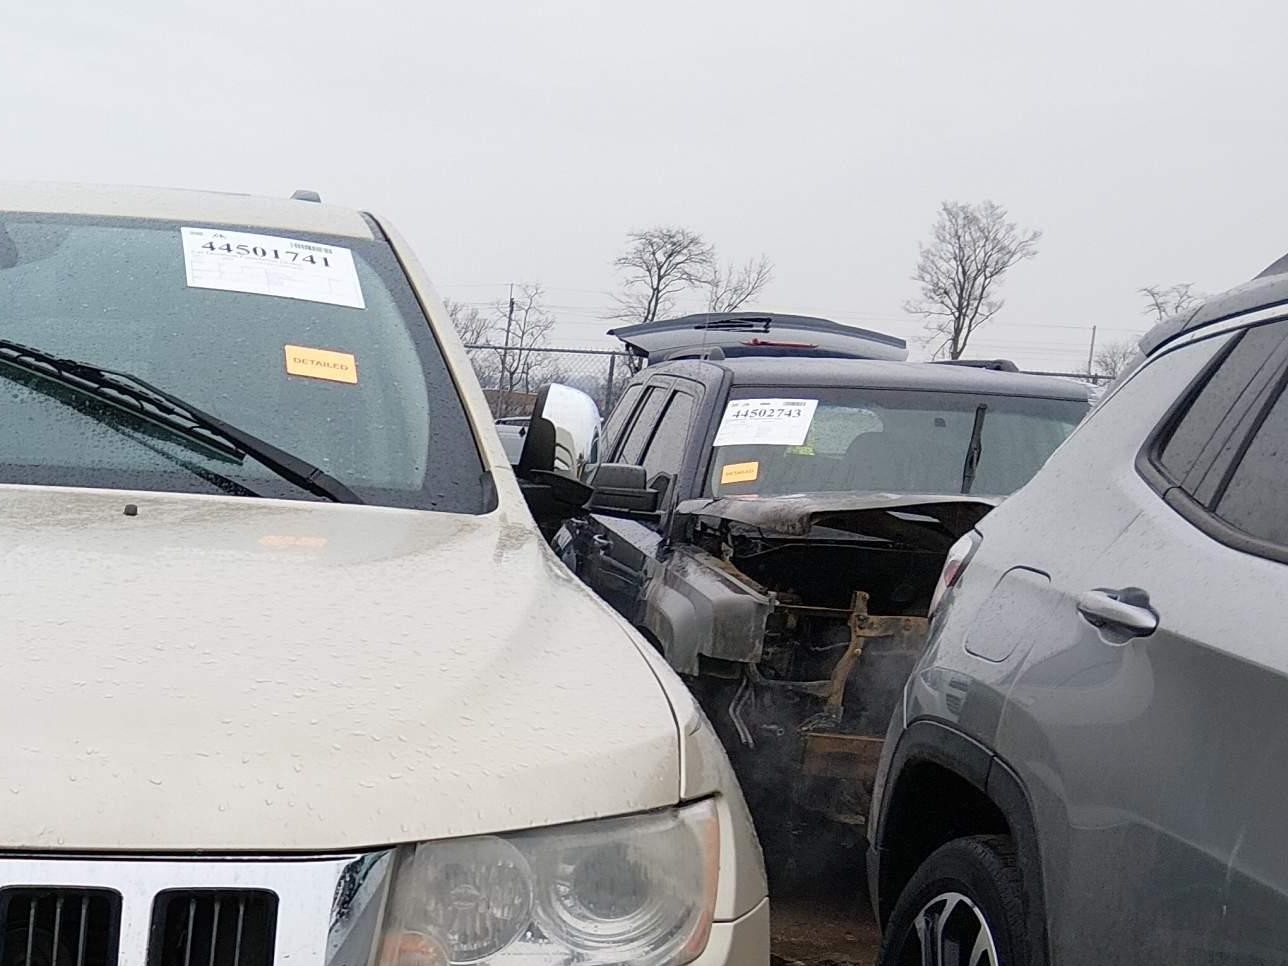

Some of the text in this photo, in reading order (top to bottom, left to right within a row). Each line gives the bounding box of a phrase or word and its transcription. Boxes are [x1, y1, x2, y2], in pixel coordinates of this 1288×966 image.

[201, 241, 331, 267] 44501741
[293, 357, 349, 371] DETAILED
[733, 408, 802, 418] 44502743
